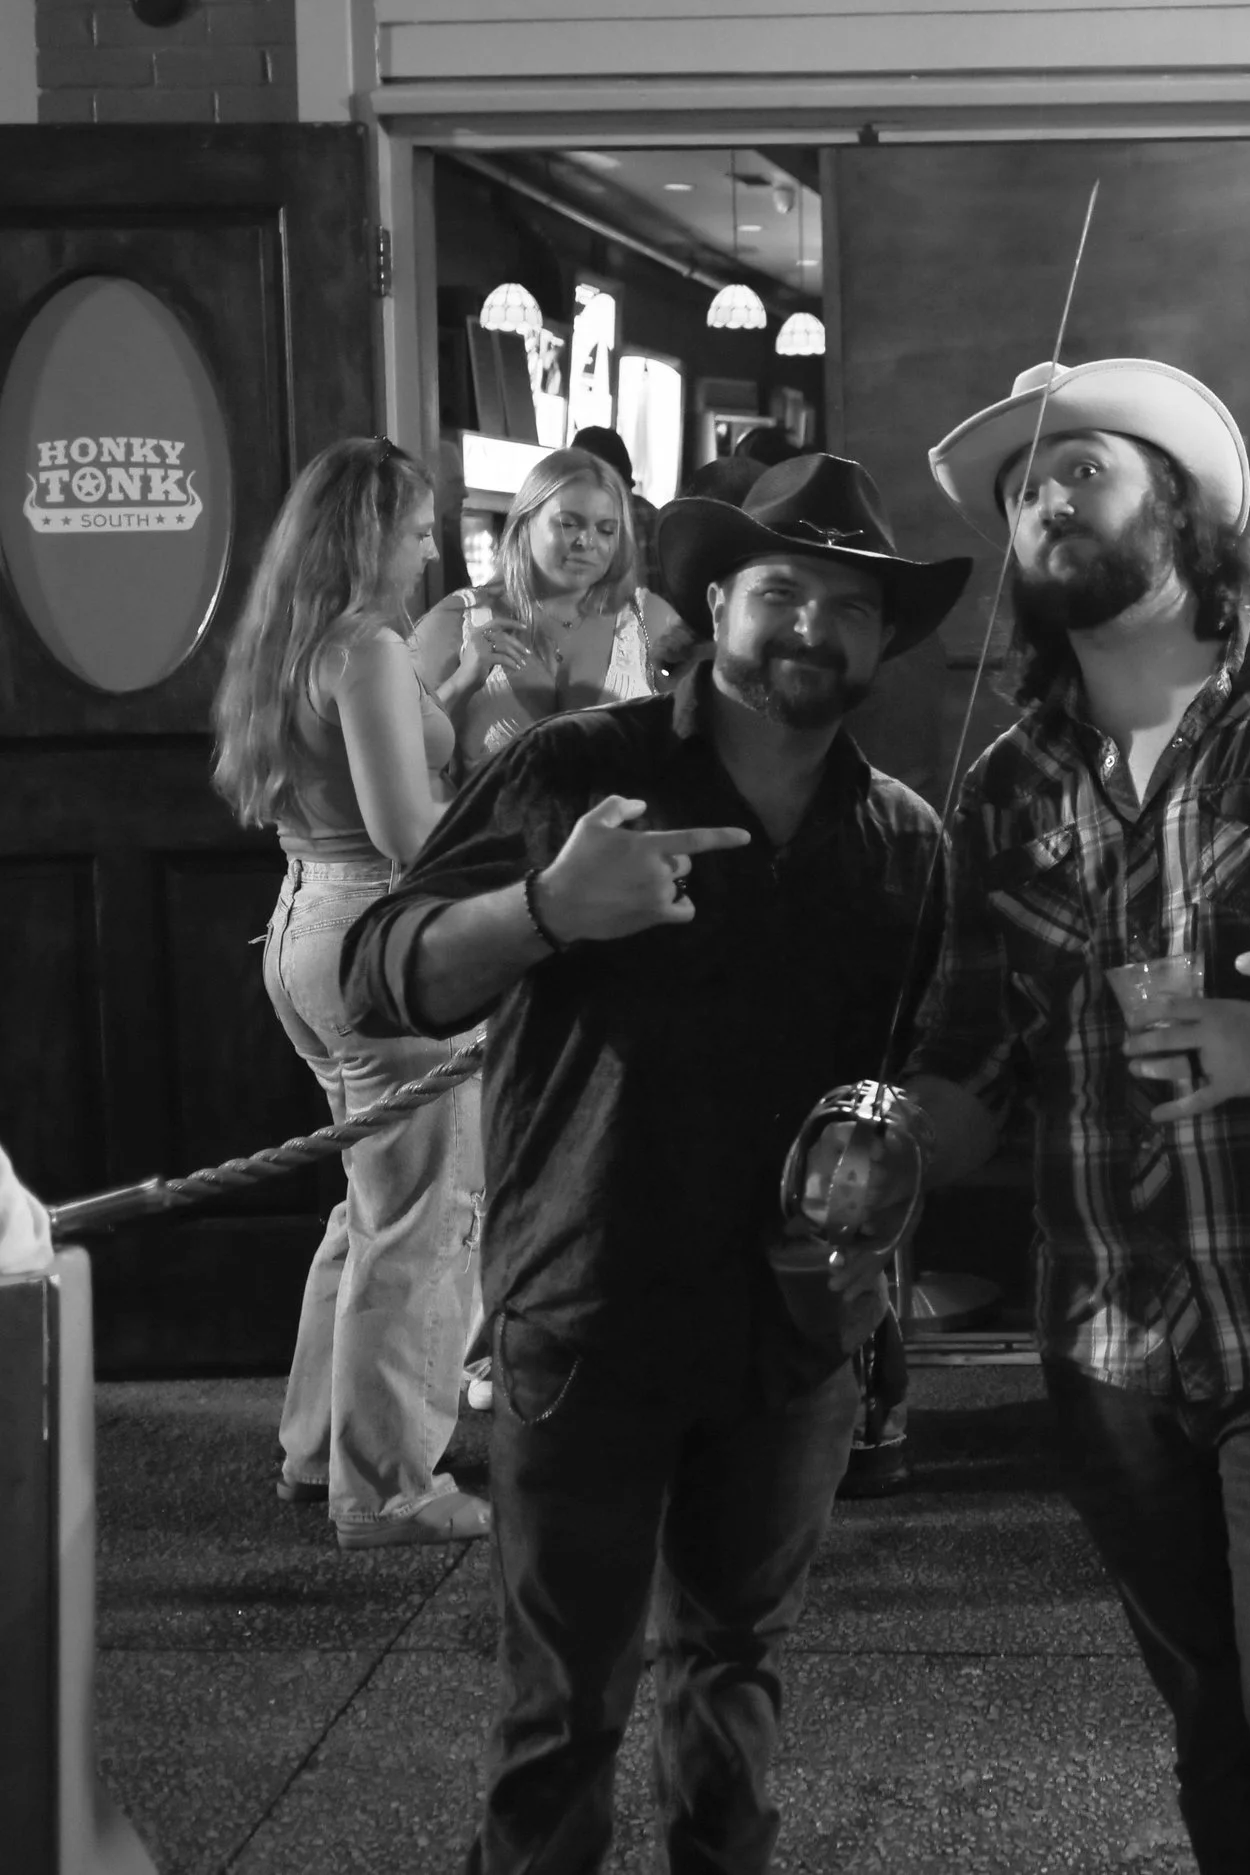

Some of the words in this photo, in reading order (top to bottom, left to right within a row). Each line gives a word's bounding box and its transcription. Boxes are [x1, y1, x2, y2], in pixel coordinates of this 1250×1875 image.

[37, 437, 185, 467] HONKY
[38, 466, 188, 503] TONK
[80, 513, 150, 528] SOUTH
